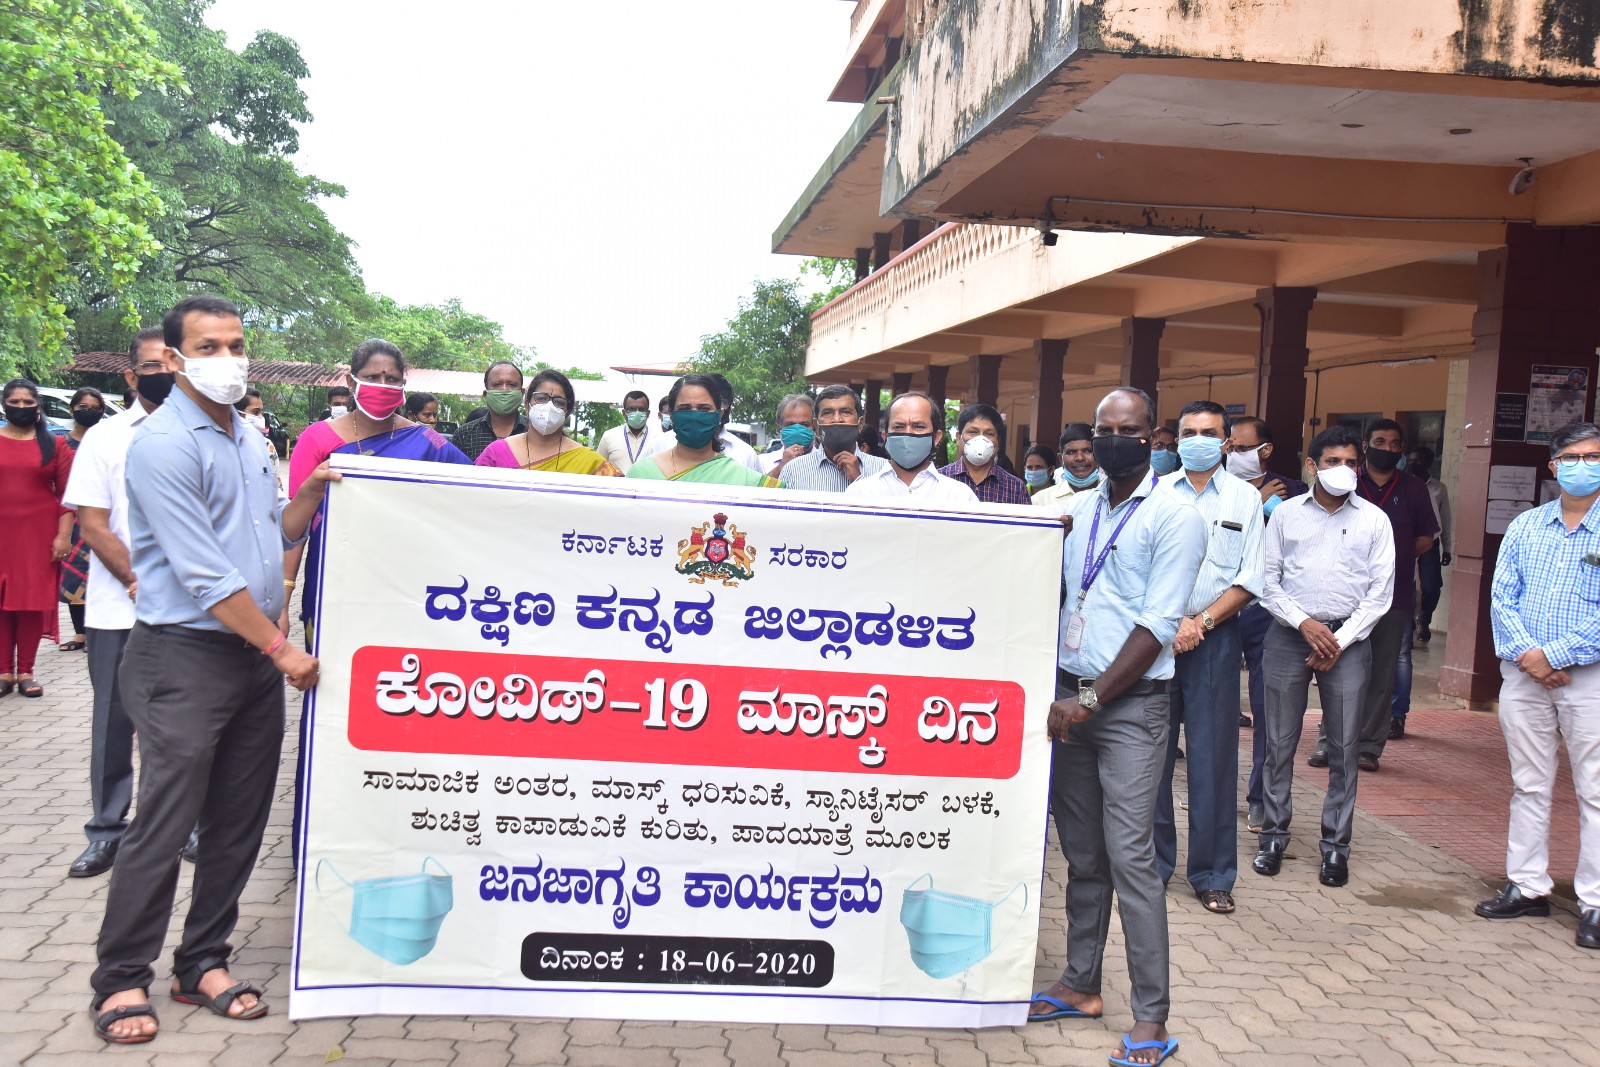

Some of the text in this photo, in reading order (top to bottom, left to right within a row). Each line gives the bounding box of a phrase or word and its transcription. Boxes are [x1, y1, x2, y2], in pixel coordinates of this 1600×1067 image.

[562, 532, 848, 569] ಕರ್ನಾಟಕ ಸರಕಾರ
[426, 575, 975, 659] ದಕ್ಷಿಣ ಕನ್ನಡ ಜಿಲ್ಲಾಡಳಿತ
[375, 654, 999, 766] ಕೋವಿಡ್-19 ಮಾಸ್ಕ್ ದಿನ
[364, 770, 999, 823] ಸಾಮಾಜಿಕ ಅಂತರ, ಮಾಸ್ಕ್ ಧರಿಸುವಿಕೆ, ಸ್ಯಾನಿಟೈಸರ್ ಬಳಕೆ,
[412, 810, 950, 855] ಶುಚಿತ್ವ ಕಾಪಾಡುವಿಕೆ ಕುರಿತು, ಪಾದಯಾತ್ರೆ ಮೂಲಕ
[480, 854, 882, 929] ಜನಜಾಗೃತಿ ಕಾರ್ಯಕ್ರಮ
[540, 947, 624, 969] ದಿನಾಂಕ
[661, 950, 815, 974] 18-06-2020
